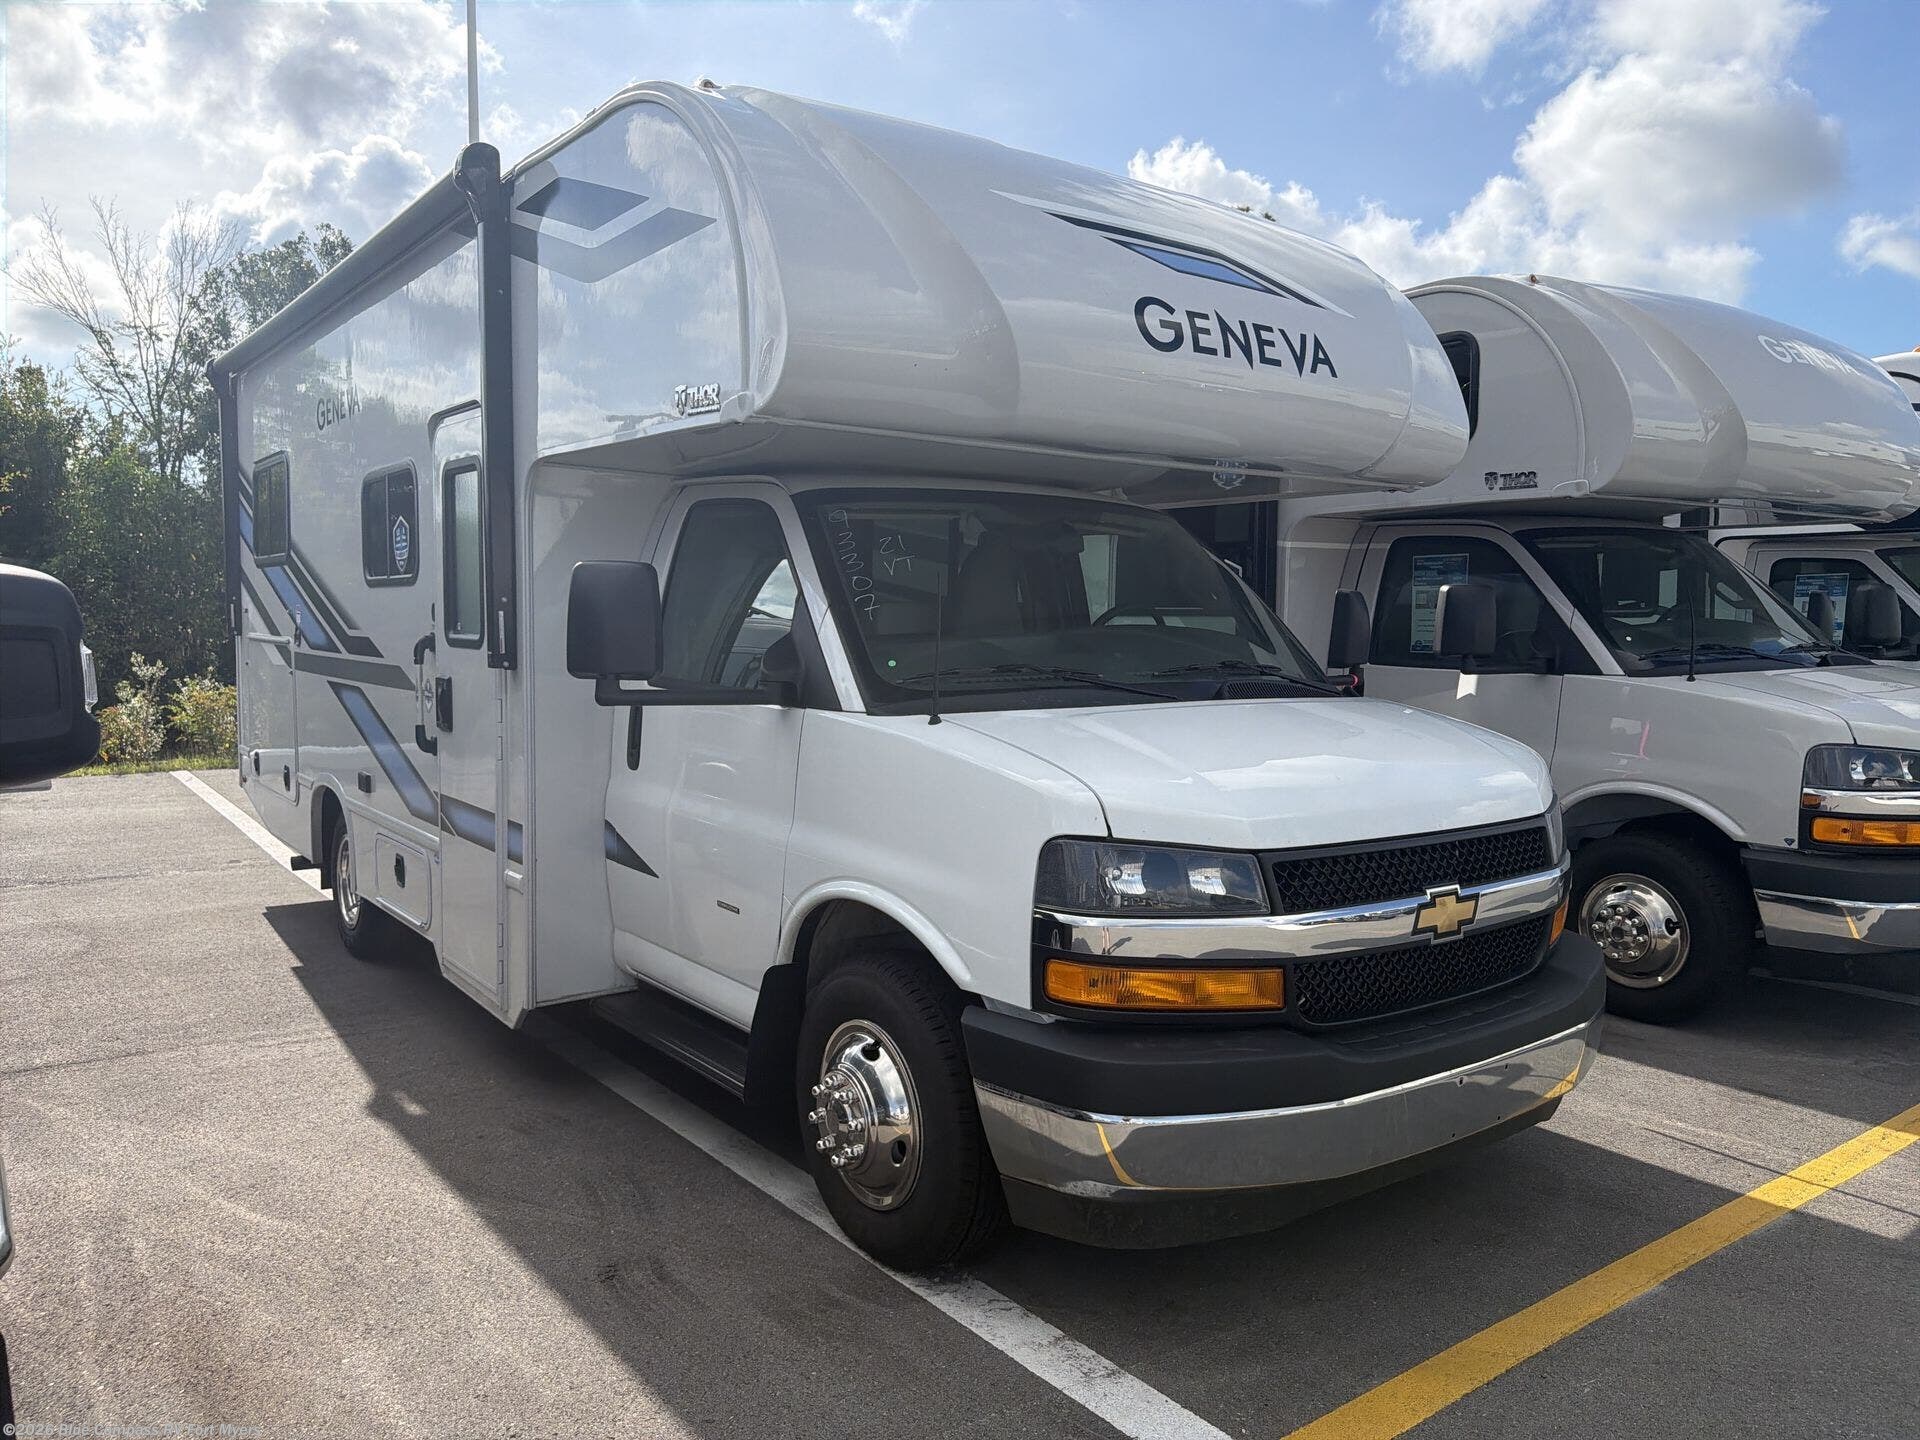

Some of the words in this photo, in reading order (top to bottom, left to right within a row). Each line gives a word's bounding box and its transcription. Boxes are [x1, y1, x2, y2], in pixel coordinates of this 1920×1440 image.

[1134, 296, 1338, 378] GENEVA
[1757, 335, 1861, 376] GENEVA
[317, 384, 361, 431] GENEVA
[687, 383, 720, 409] THOR
[1499, 471, 1538, 486] THOR
